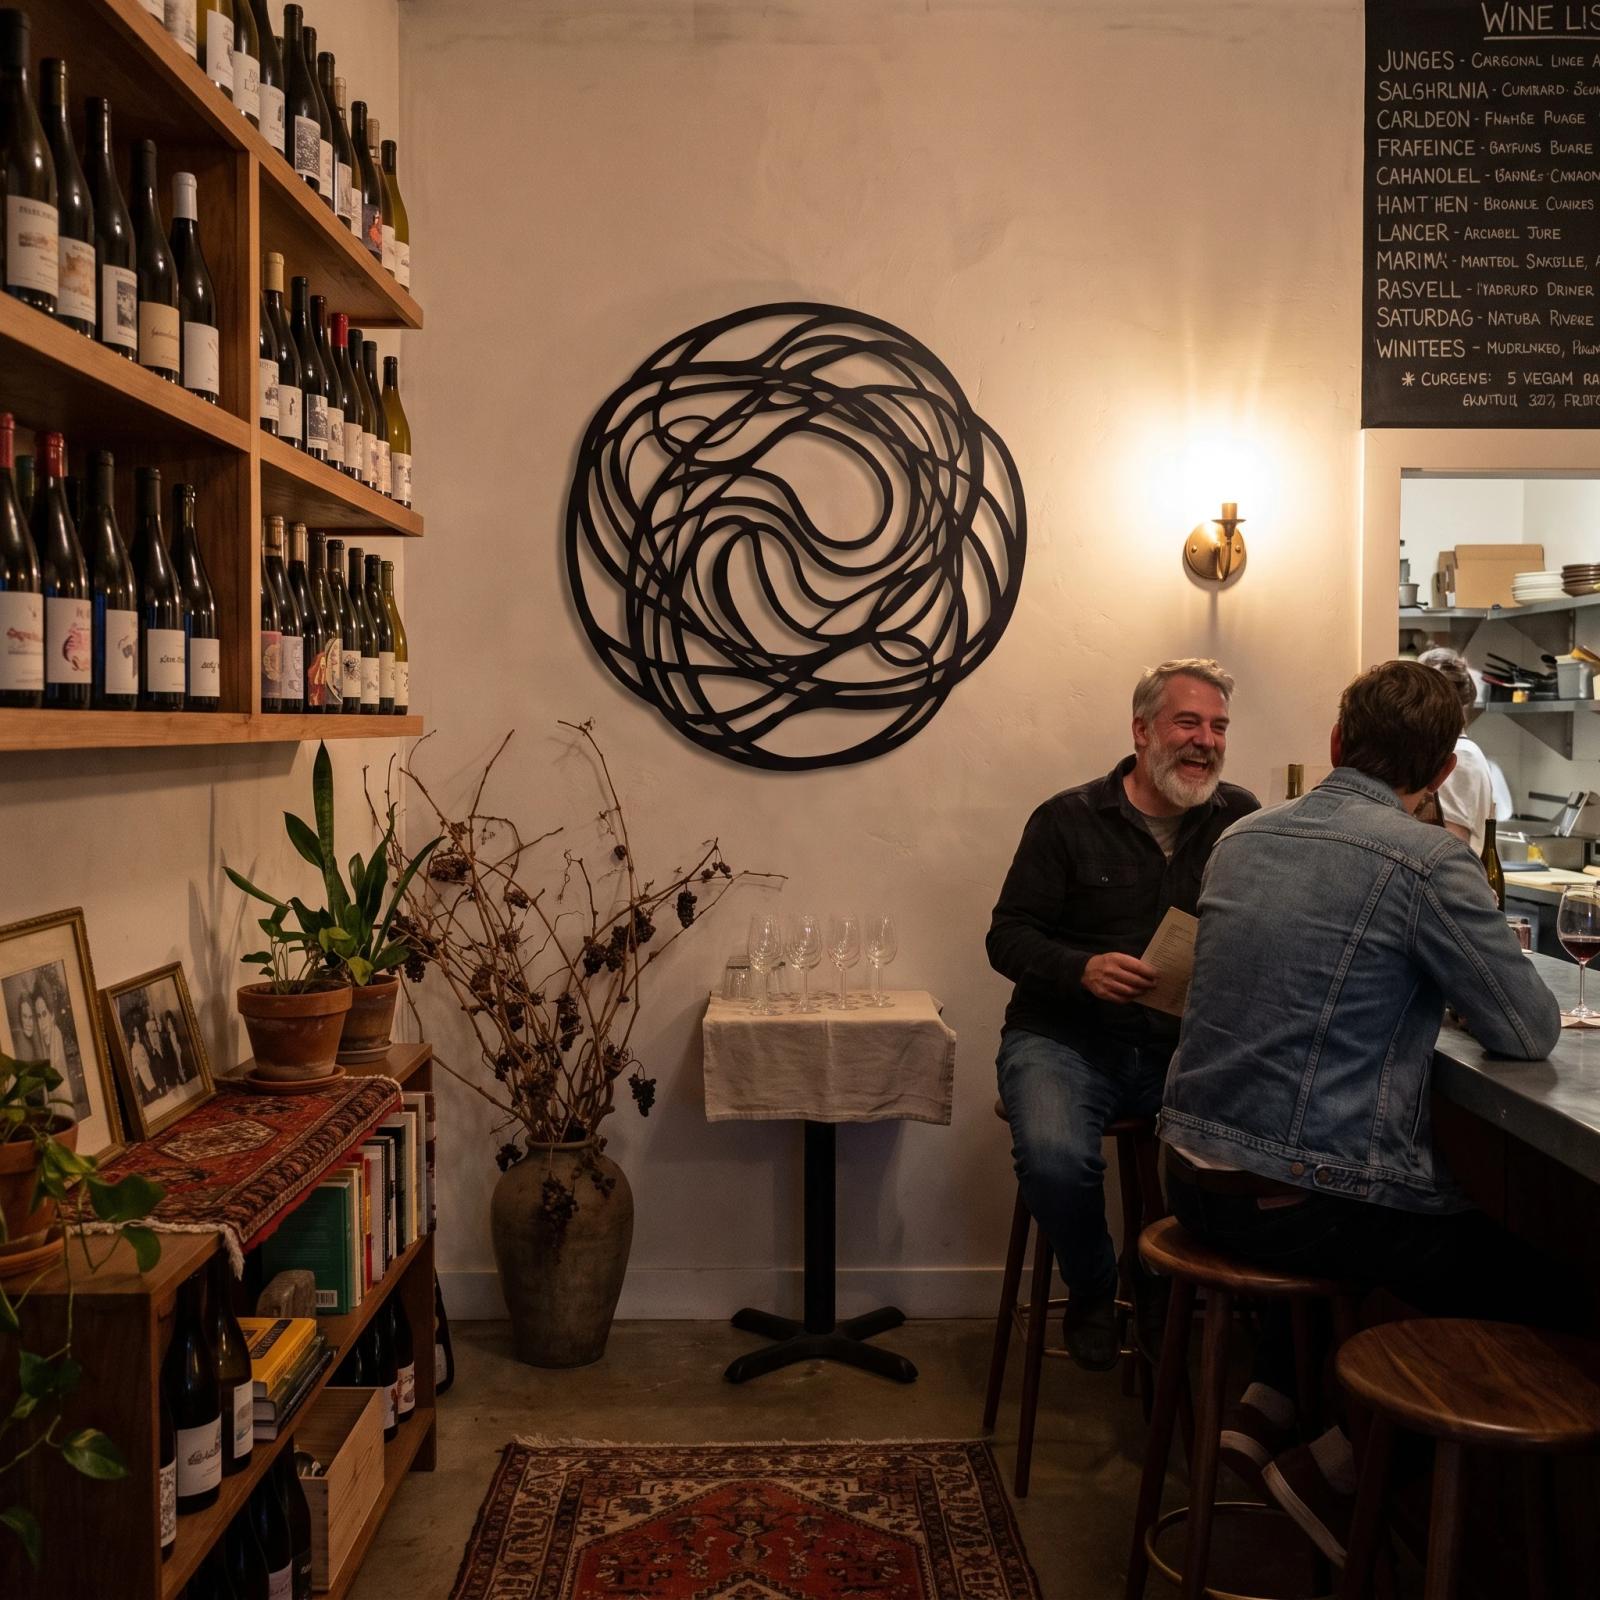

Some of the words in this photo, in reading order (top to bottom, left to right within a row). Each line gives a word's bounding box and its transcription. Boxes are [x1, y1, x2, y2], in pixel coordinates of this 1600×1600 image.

[1481, 1, 1554, 33] WINE
[1378, 49, 1455, 73] JUNGES
[1377, 109, 1470, 130] CARLDEON
[1378, 138, 1476, 158] FRAFEINCE
[1550, 140, 1593, 156] BUARE
[1376, 166, 1481, 186] CAHANOLEL
[1378, 223, 1450, 243] LANCER
[1527, 226, 1562, 240] JURE
[1377, 278, 1462, 301] RASVELL
[1547, 281, 1595, 297] DRINER
[1376, 306, 1474, 328] SATURDAG
[1487, 310, 1541, 327] NATUBA
[1376, 338, 1466, 359] WINITEES
[1507, 371, 1518, 386] 5
